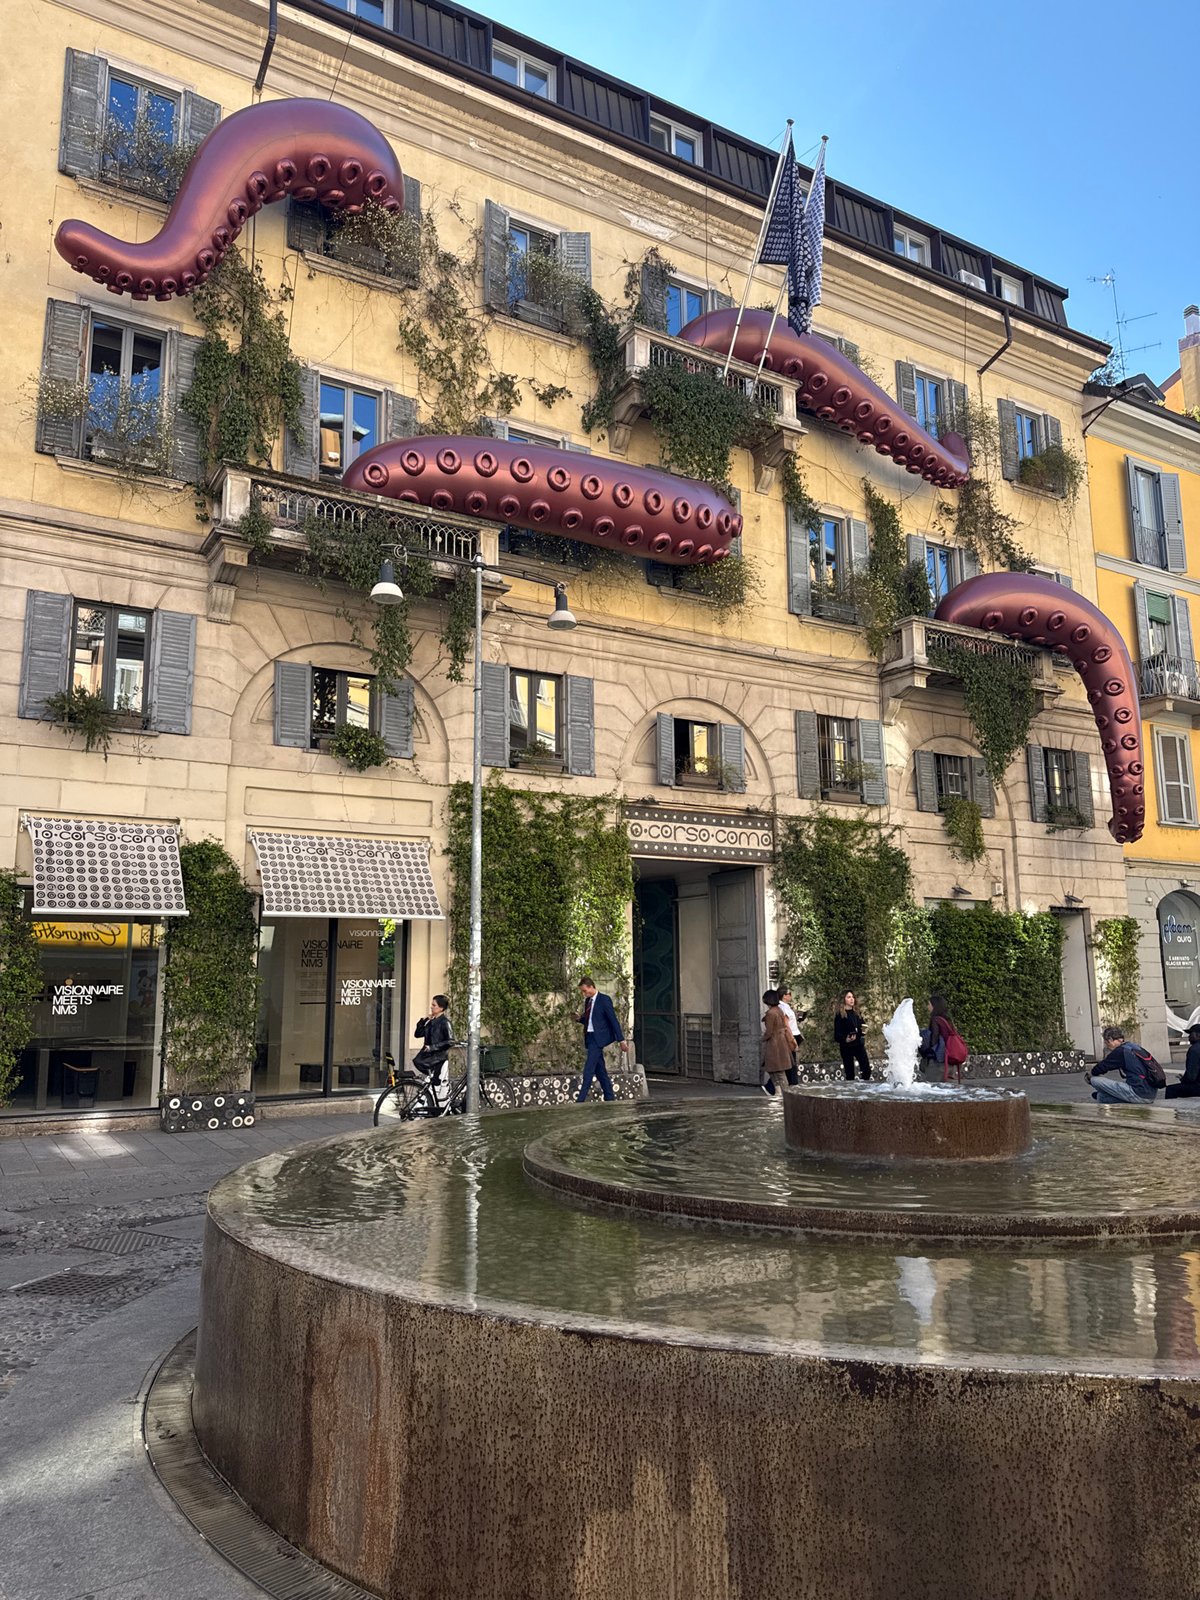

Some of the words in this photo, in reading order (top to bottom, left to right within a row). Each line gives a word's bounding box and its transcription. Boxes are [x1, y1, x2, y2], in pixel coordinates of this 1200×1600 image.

[302, 940, 363, 949] VISIONAIRE
[301, 959, 323, 968] NM3
[342, 979, 397, 988] VISIONNAIRE
[54, 985, 124, 995] VISIONNAIRE
[341, 988, 373, 997] MEETS
[52, 995, 92, 1005] MEETS
[340, 996, 361, 1006] NM3
[52, 1005, 78, 1015] NM3
